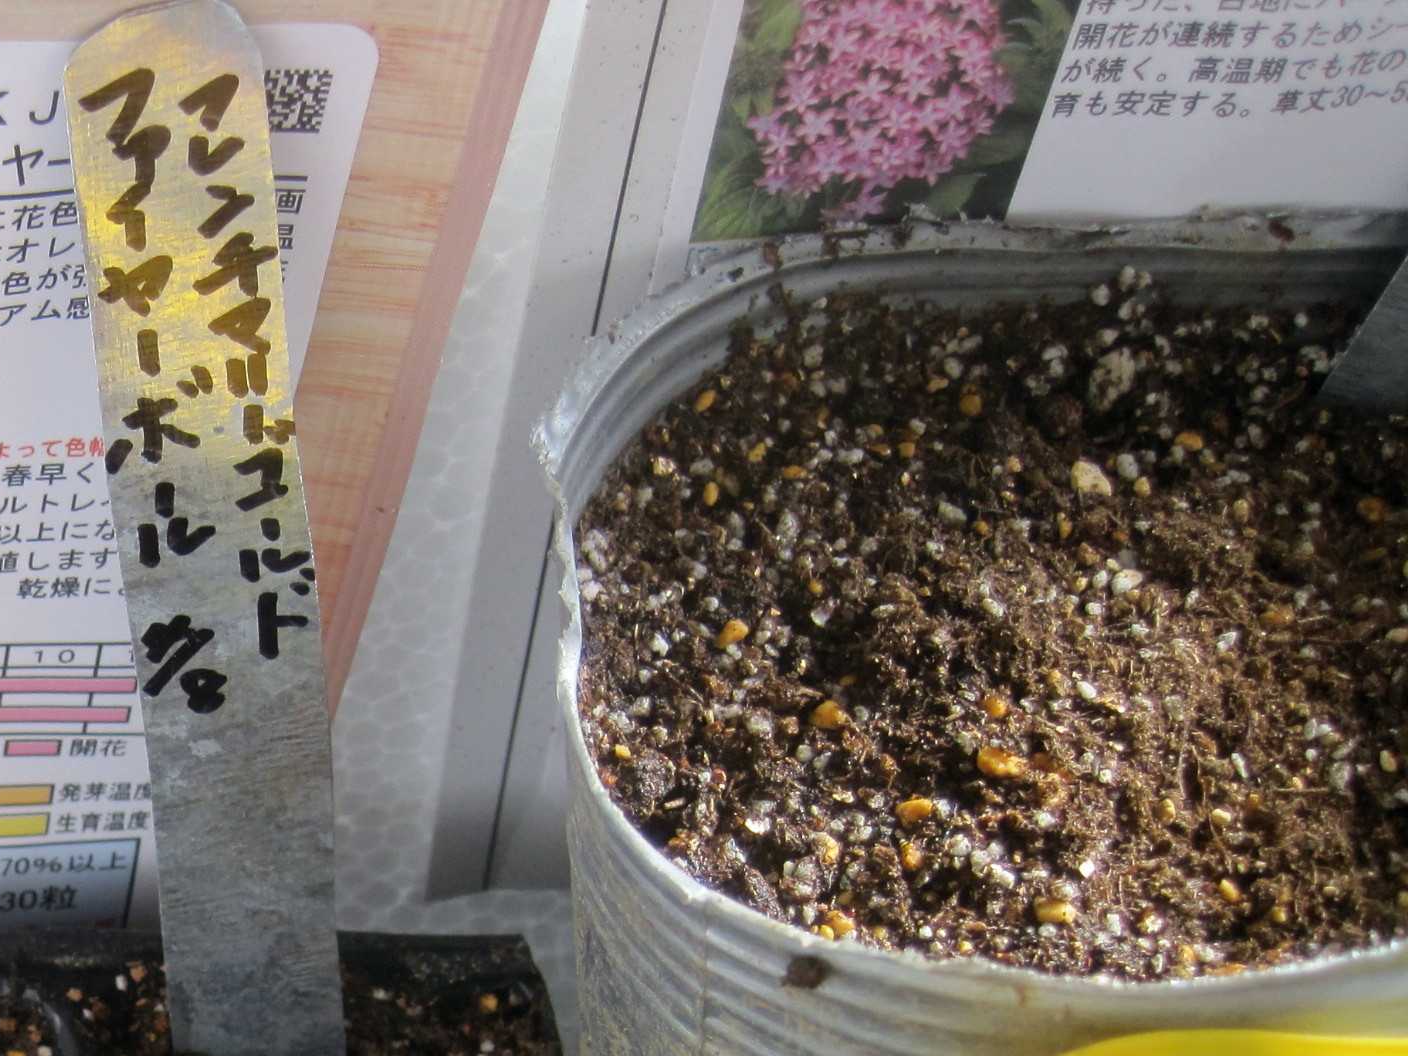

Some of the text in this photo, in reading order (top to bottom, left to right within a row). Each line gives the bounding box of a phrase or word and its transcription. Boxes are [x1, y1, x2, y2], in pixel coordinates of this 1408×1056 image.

[1051, 80, 1408, 119] 育も安定する。草丈30～5
[33, 648, 76, 664] 10
[69, 738, 127, 758] 開花
